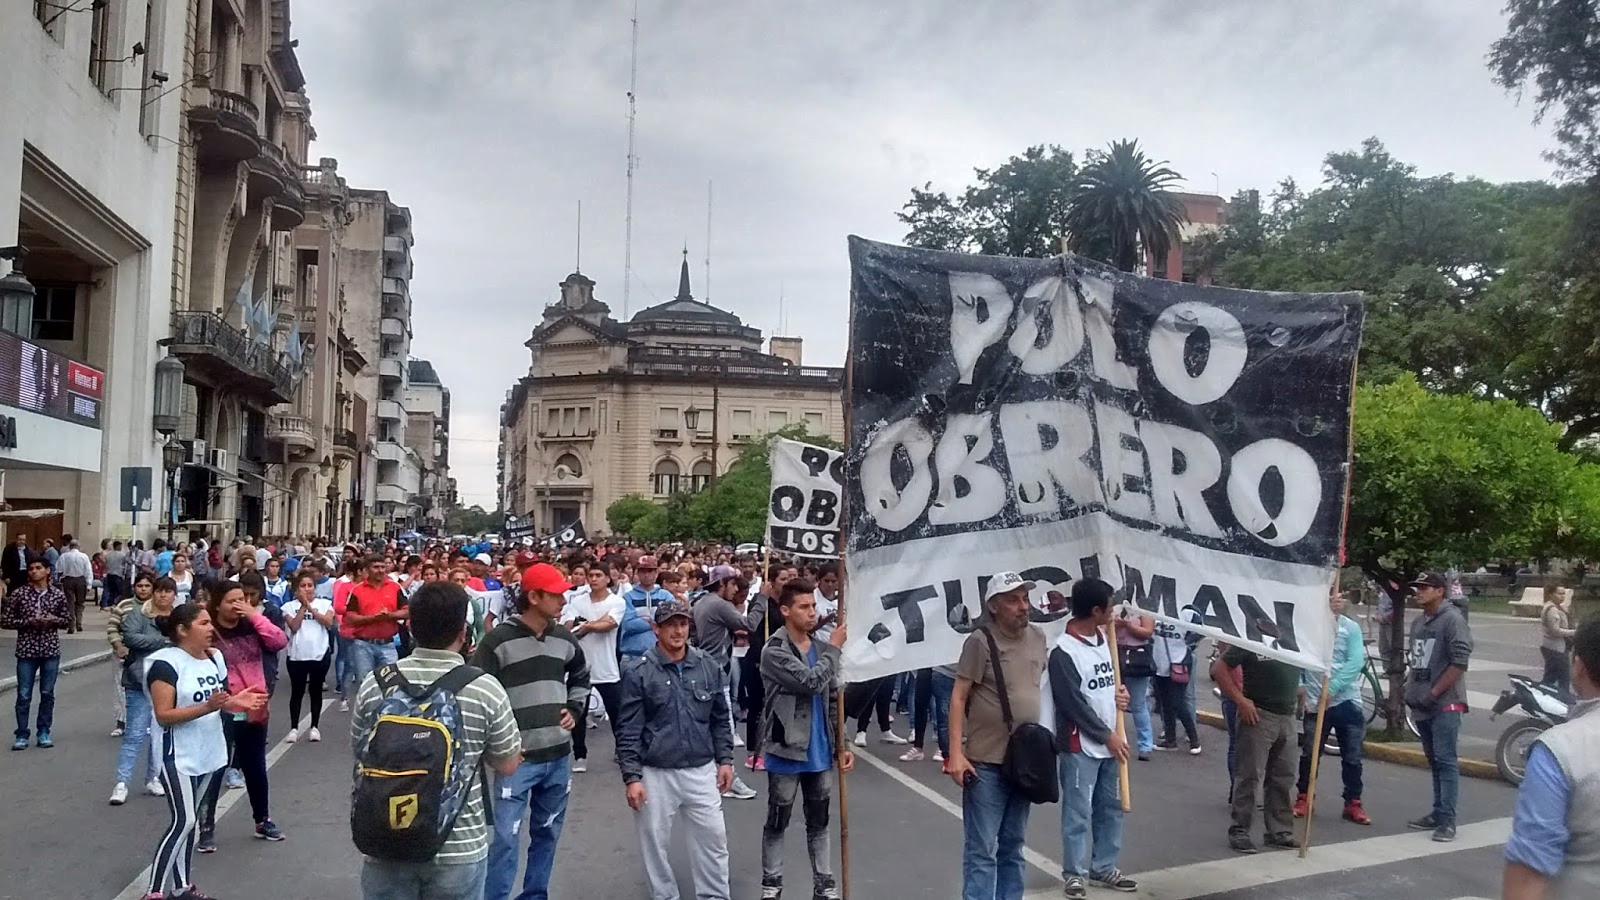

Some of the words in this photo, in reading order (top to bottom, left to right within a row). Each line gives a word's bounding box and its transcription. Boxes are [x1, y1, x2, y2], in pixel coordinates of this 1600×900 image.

[949, 271, 1247, 405] POLO
[771, 485, 838, 526] OB
[860, 400, 1323, 547] OBRERO
[785, 529, 835, 553] LOS
